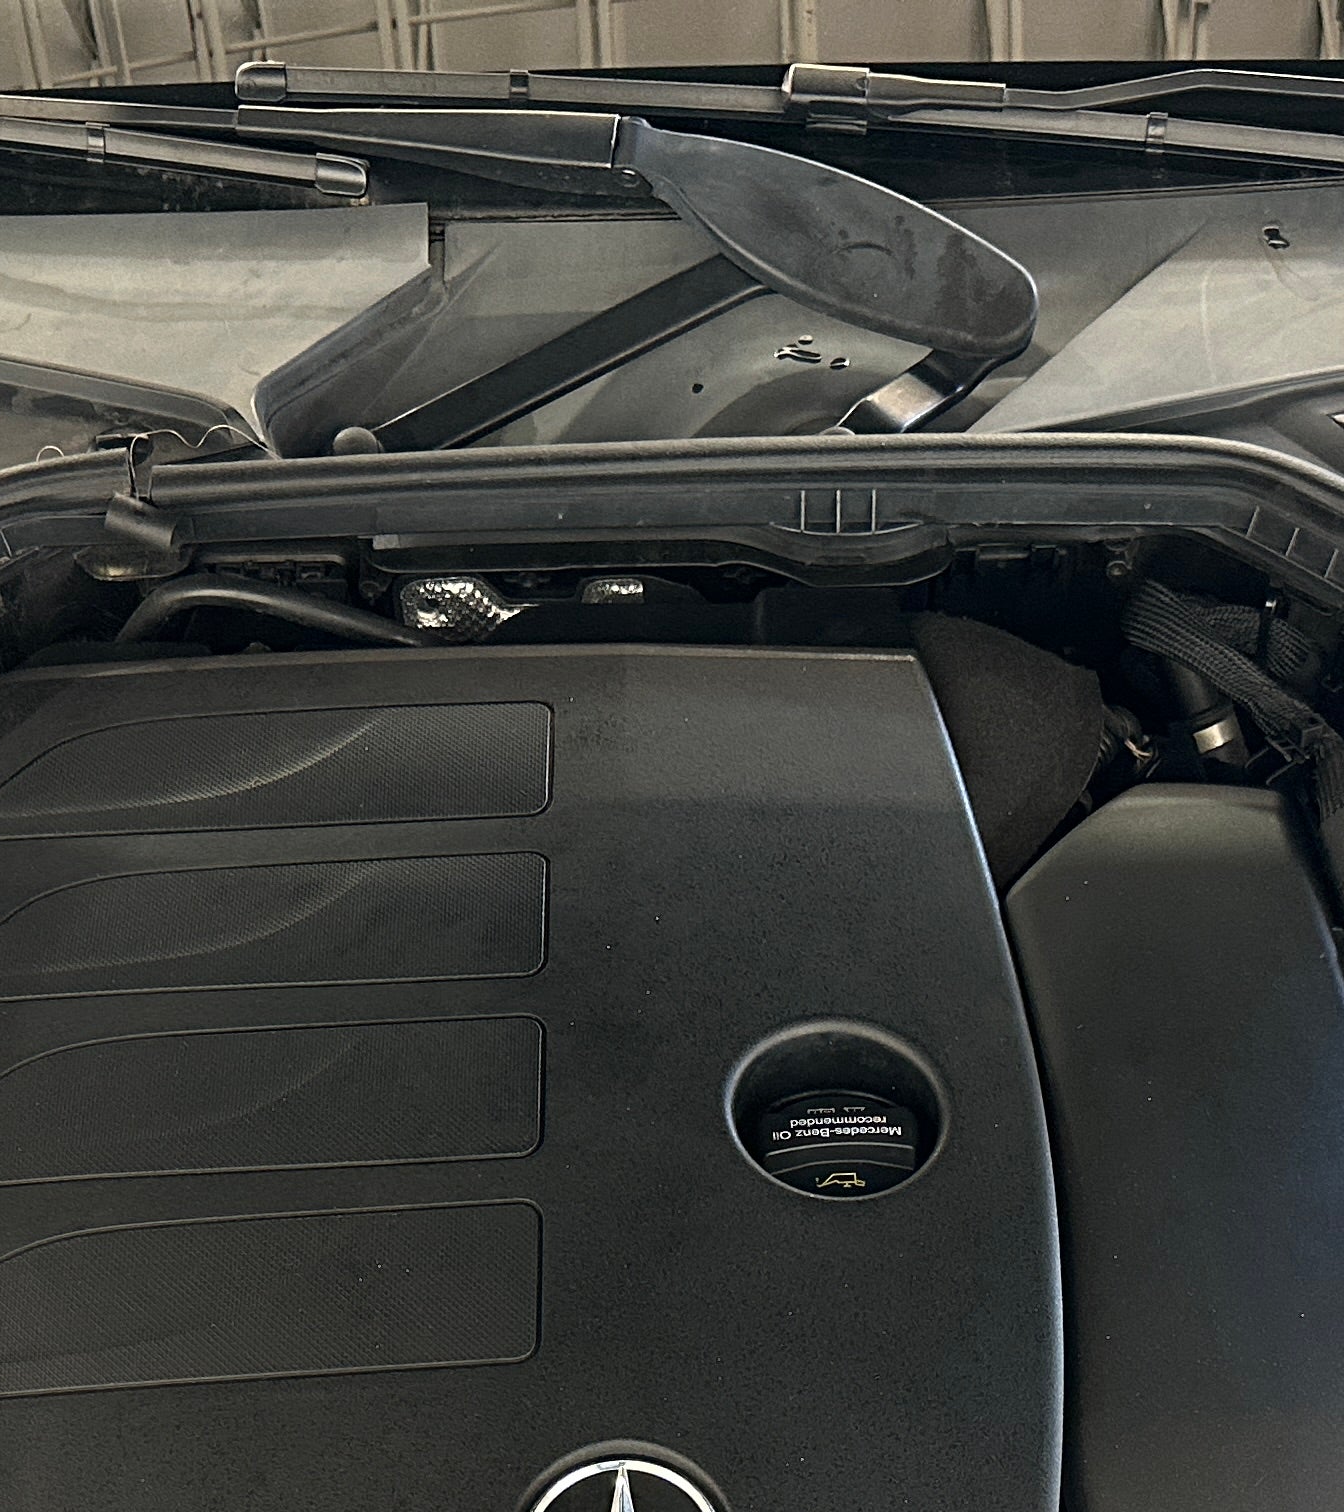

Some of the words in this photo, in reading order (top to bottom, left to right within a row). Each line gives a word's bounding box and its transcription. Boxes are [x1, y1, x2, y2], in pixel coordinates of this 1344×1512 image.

[790, 1115, 887, 1128] recommended
[772, 1129, 792, 1141] Oil
[795, 1125, 902, 1138] Mercedes-Benz
